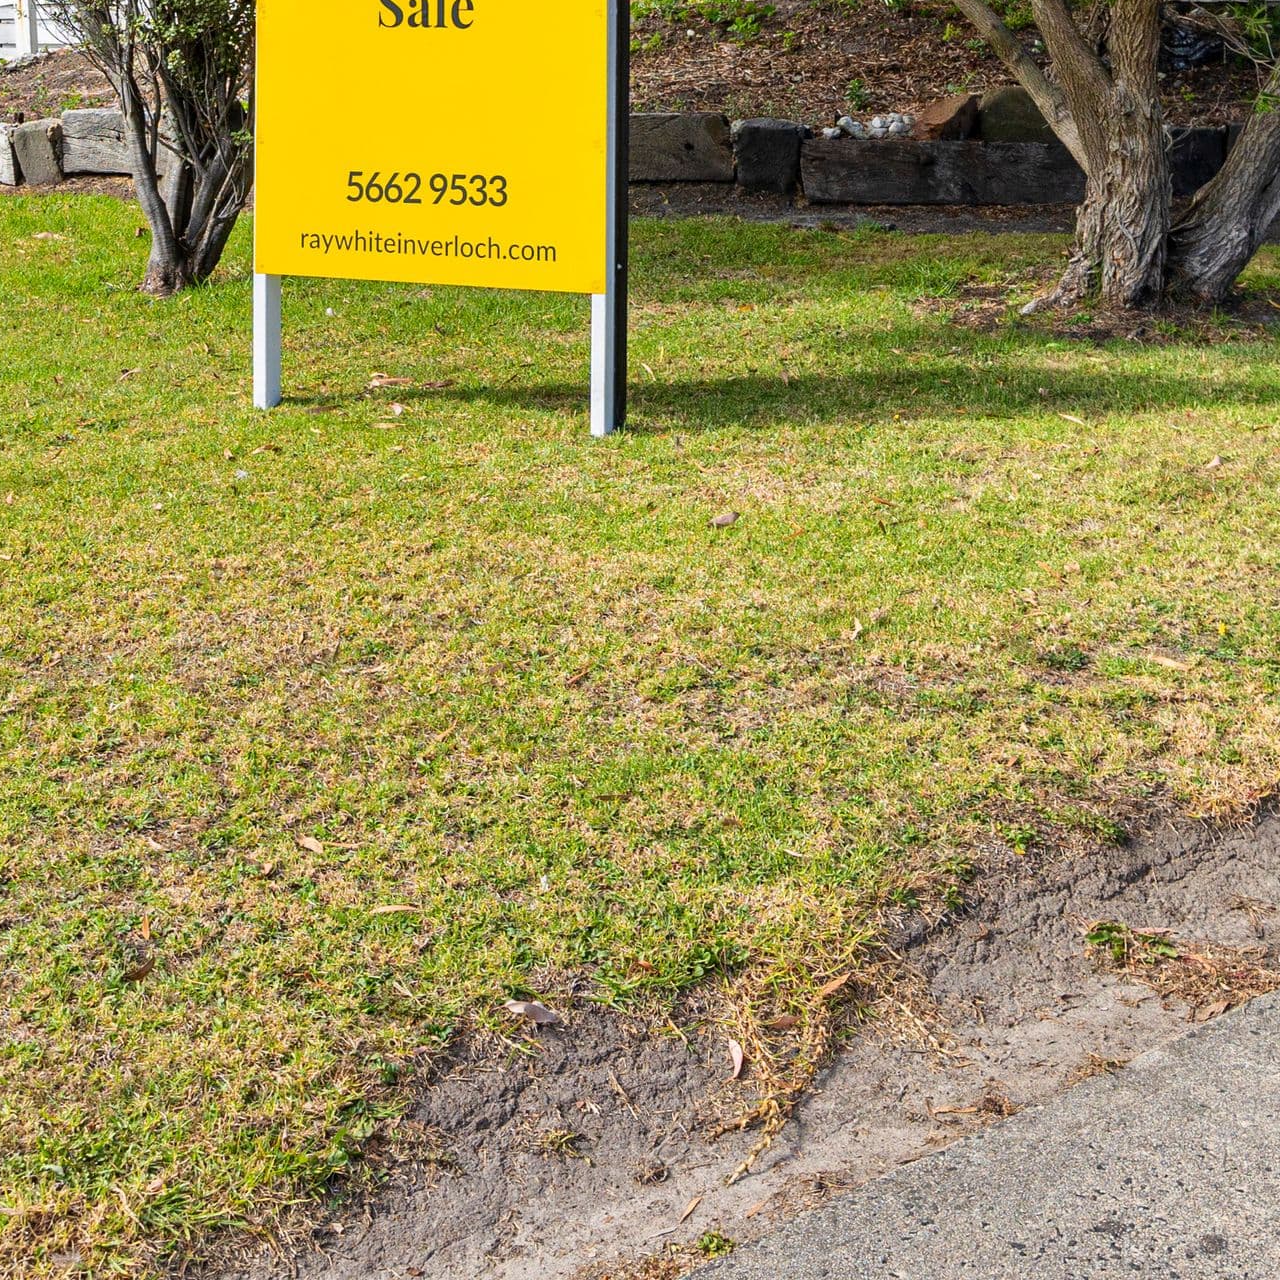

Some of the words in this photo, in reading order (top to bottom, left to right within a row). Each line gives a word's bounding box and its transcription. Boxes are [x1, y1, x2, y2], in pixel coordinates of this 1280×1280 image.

[346, 170, 422, 204] 5662
[429, 173, 508, 207] 9533
[300, 229, 557, 262] raywhiteinverloch.com
